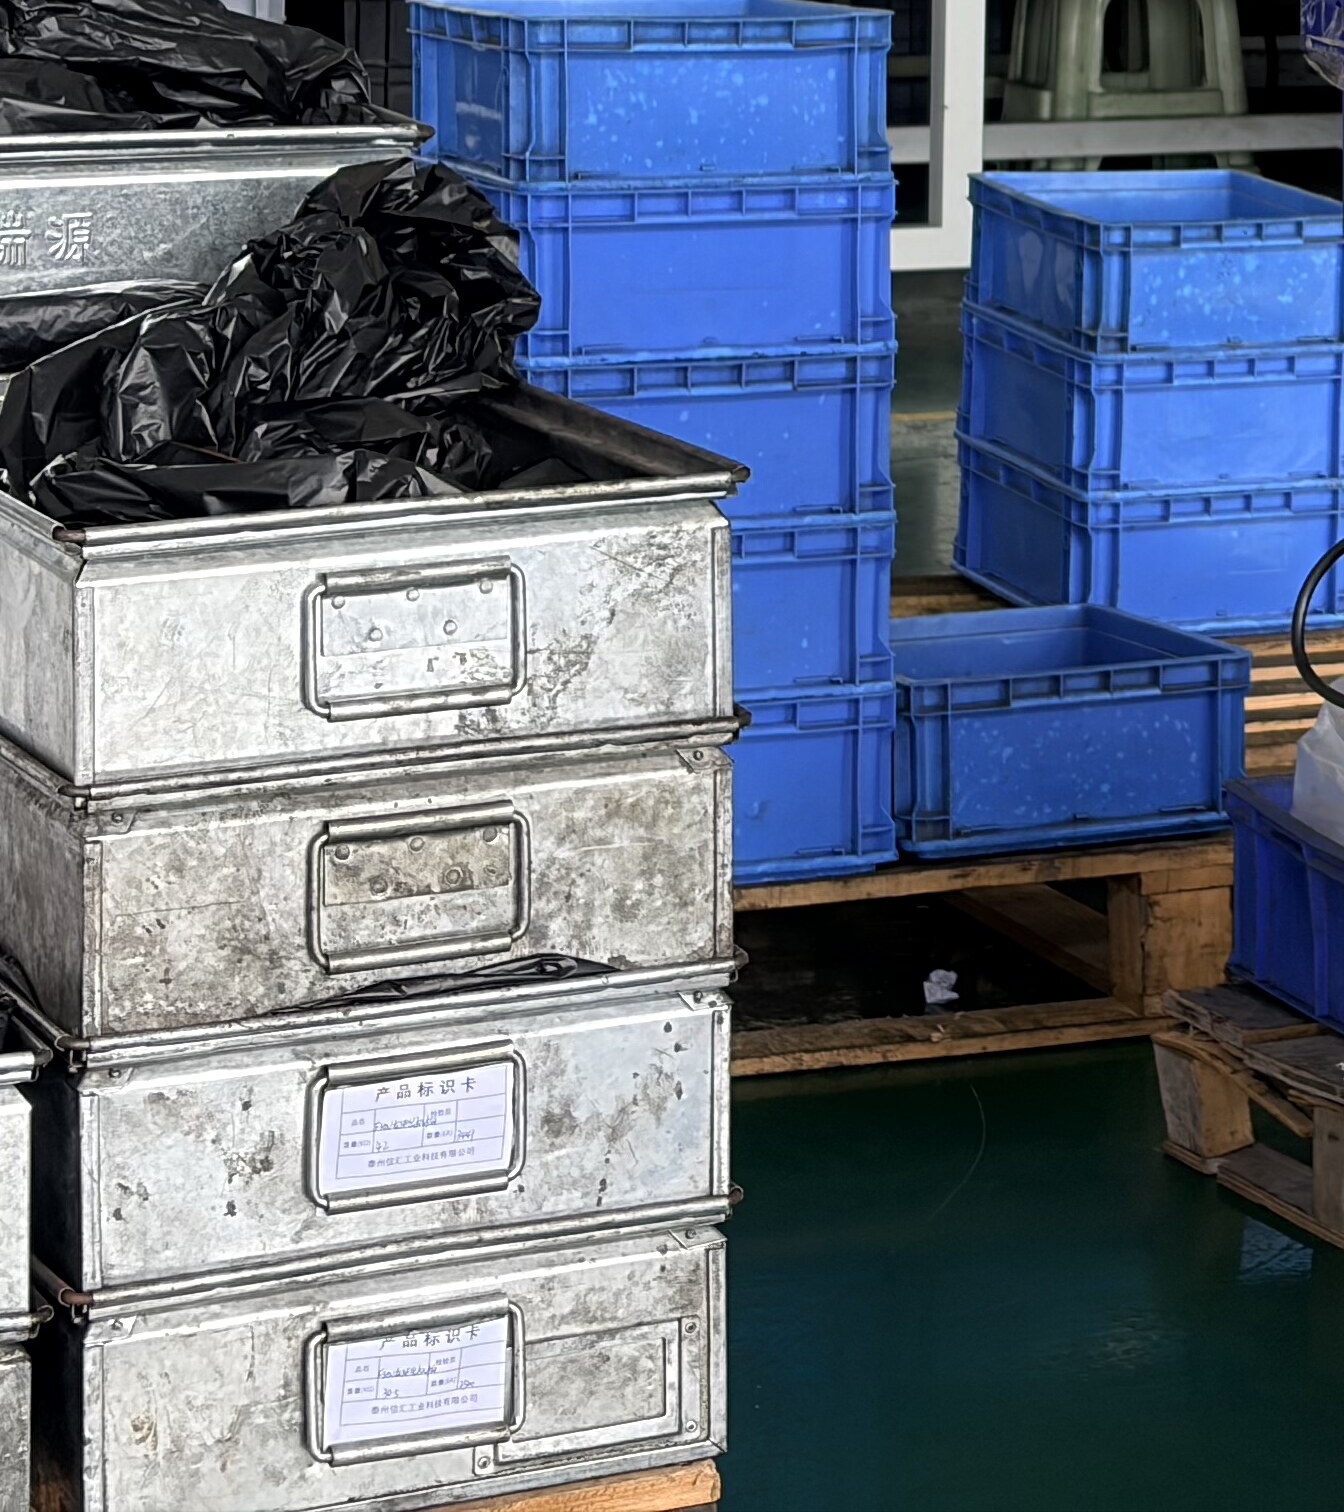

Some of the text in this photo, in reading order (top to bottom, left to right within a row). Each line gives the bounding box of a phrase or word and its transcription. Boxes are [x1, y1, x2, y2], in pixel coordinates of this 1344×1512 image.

[375, 1076, 477, 1103] 产品标识卡
[379, 1325, 481, 1351] 产品标识卡
